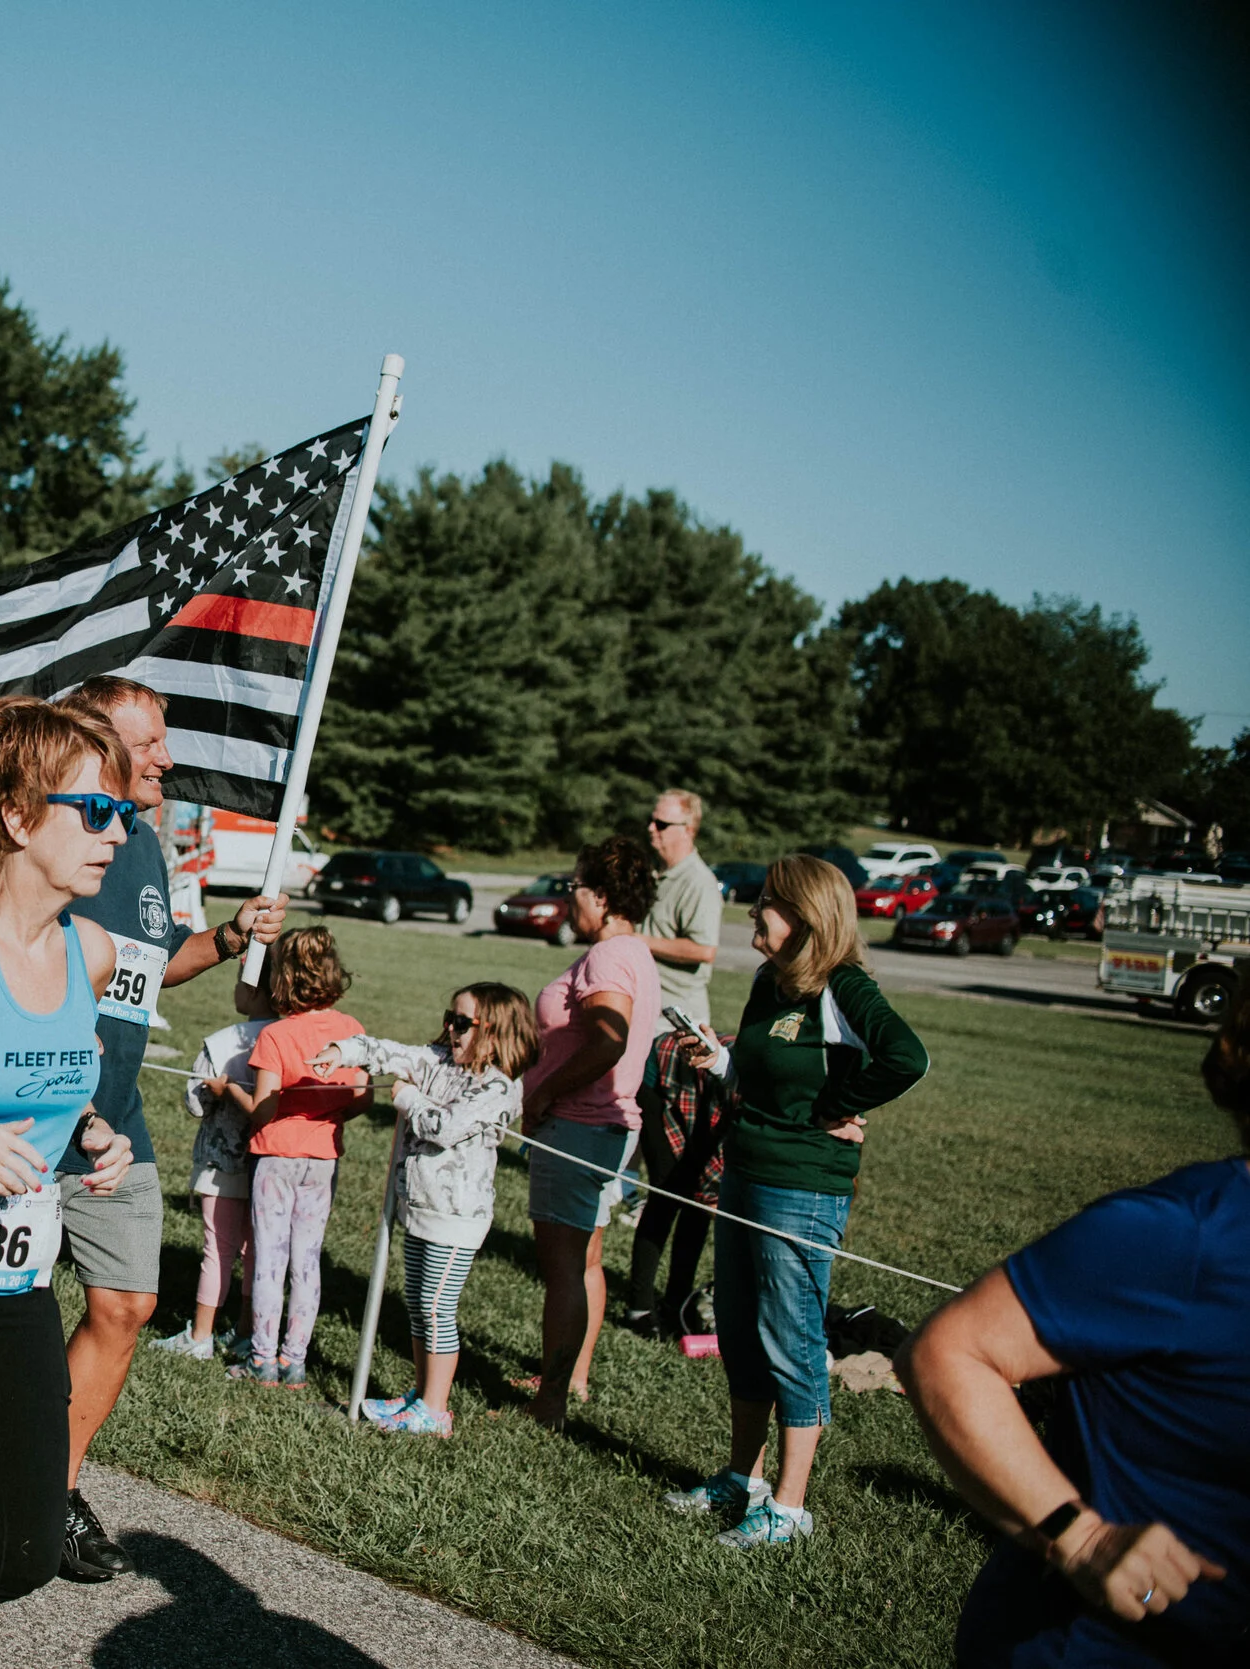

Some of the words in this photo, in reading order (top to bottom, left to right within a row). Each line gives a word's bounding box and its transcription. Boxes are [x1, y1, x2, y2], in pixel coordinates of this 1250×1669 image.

[4, 1052, 56, 1068] FLEET
[60, 1050, 93, 1066] FEET
[15, 1068, 88, 1099] Sports
[9, 1275, 29, 1287] 2019
